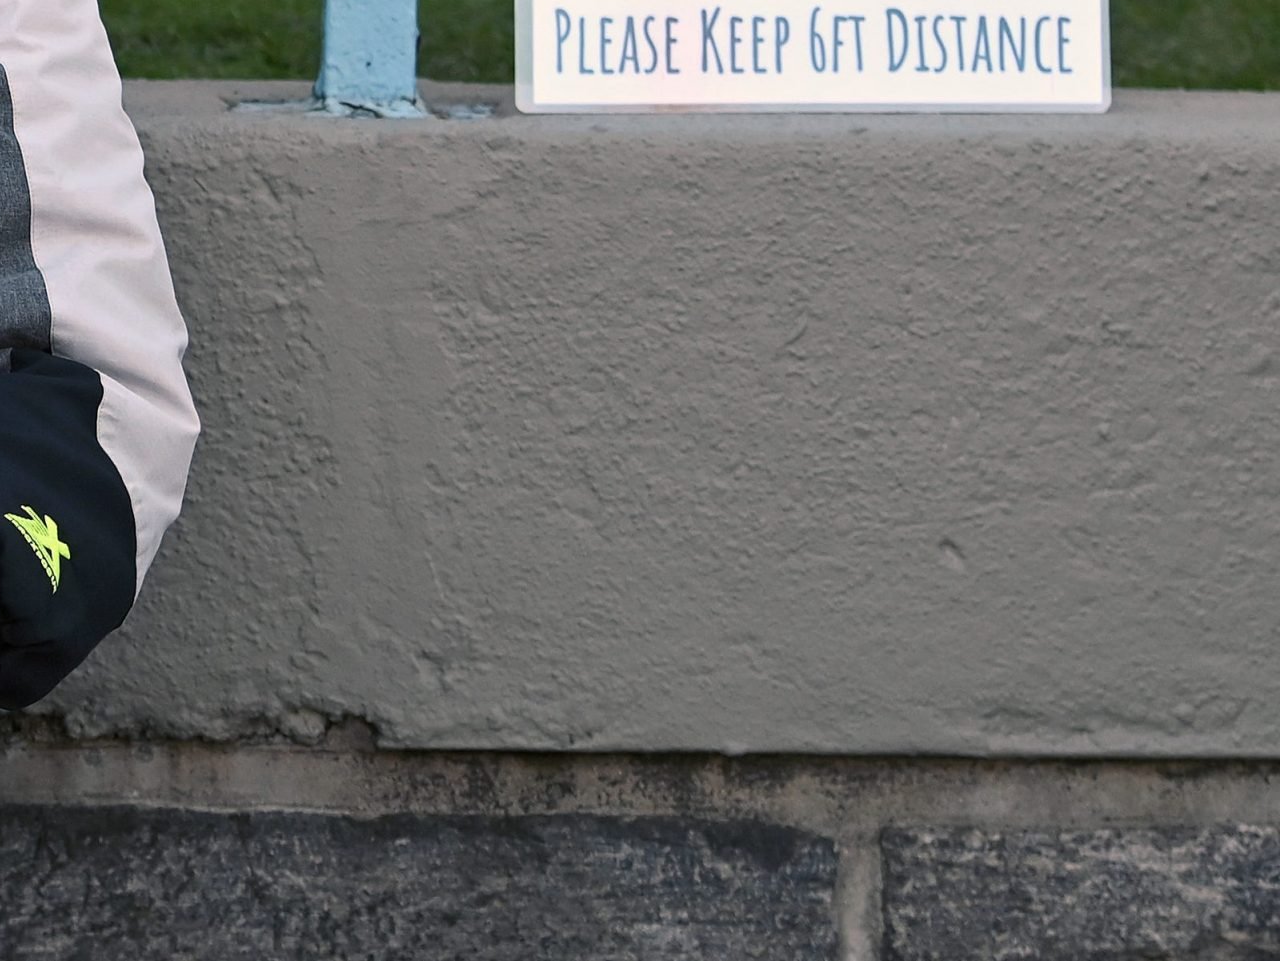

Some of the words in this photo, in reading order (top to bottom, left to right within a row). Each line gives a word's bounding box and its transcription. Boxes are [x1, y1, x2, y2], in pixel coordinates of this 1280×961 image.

[554, 8, 680, 75] PLEASE
[700, 6, 790, 75] KEEP
[809, 6, 866, 74] 6FT
[885, 7, 1073, 74] DISTANCE
